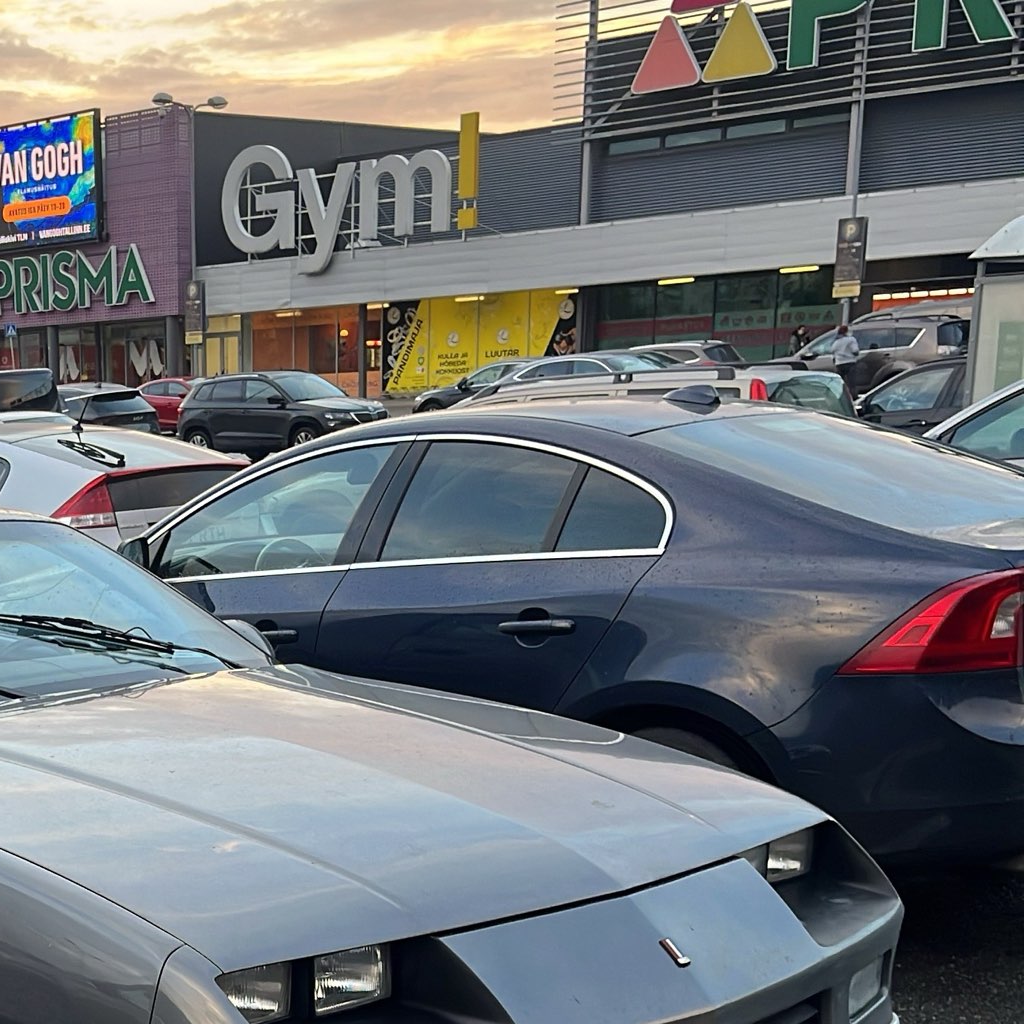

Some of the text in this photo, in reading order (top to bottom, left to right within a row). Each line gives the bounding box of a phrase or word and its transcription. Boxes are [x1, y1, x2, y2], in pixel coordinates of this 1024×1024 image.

[31, 139, 83, 179] GOGH
[392, 318, 424, 386] PANDIMAJA
[484, 349, 520, 358] LUUTAR
